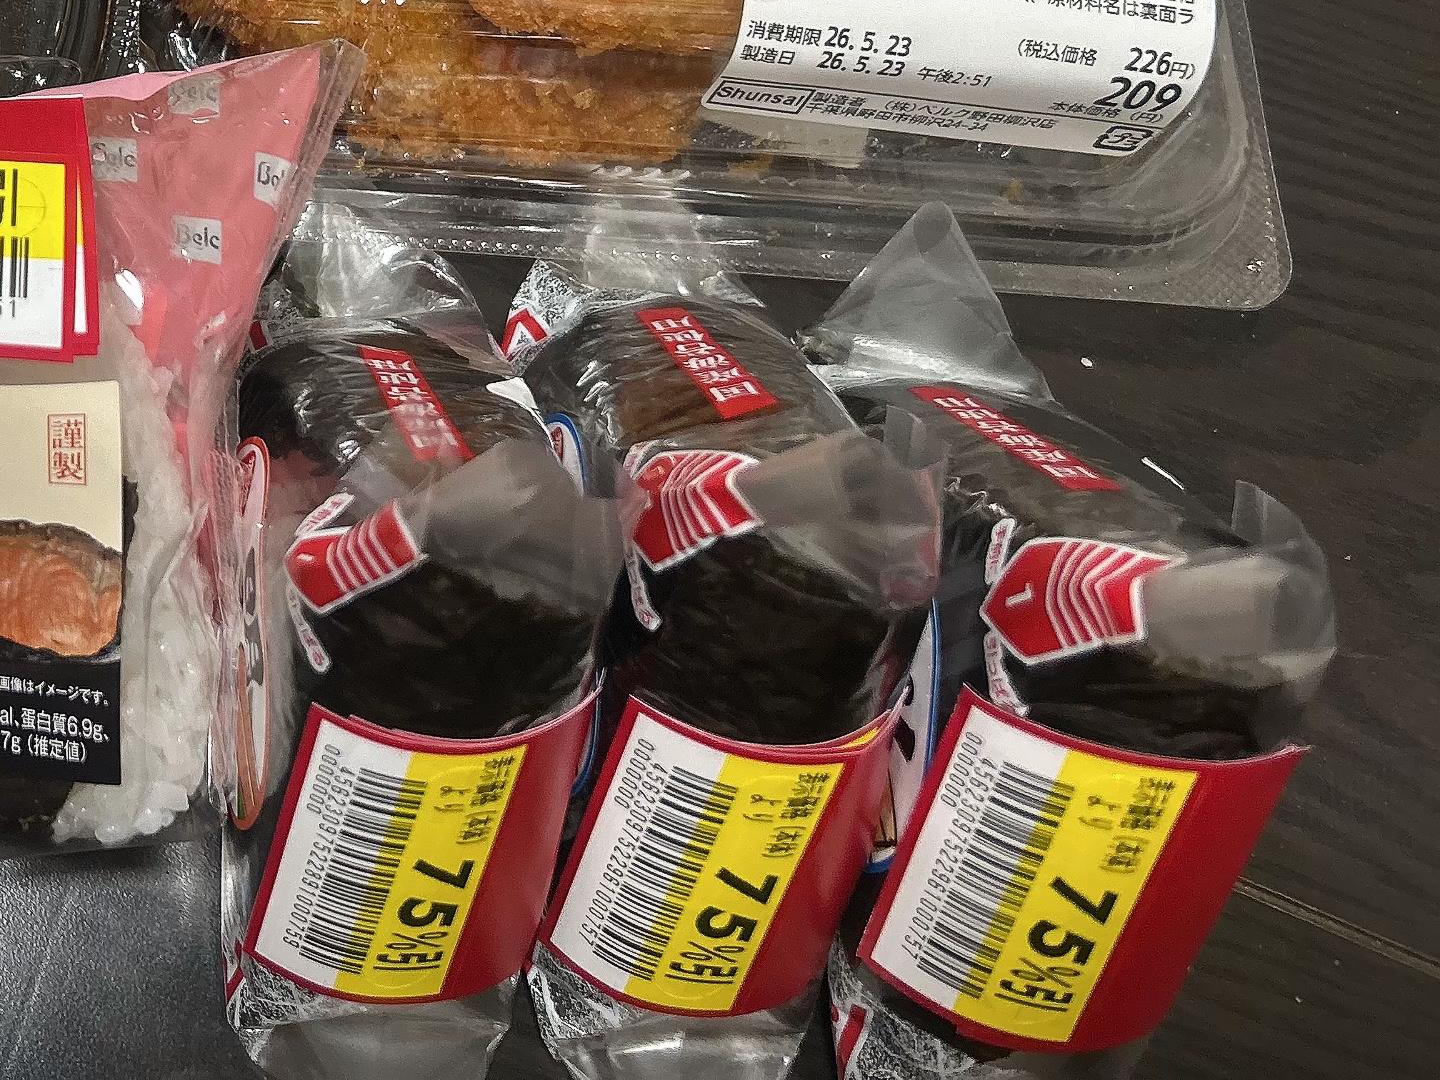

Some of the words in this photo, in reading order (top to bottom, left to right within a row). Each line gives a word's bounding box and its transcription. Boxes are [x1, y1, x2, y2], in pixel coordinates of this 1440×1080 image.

[740, 43, 797, 66] 製造日
[746, 19, 823, 47] 消費期限
[1016, 38, 1098, 68] (税込価格
[811, 91, 867, 108] 製造者
[1092, 75, 1183, 114] 209
[176, 223, 220, 249] Belc
[51, 419, 85, 481] 謹製
[307, 743, 341, 816] 0000000
[433, 785, 474, 814] より
[614, 737, 656, 808] 0000000
[940, 731, 984, 808] 0000000
[742, 793, 783, 823] より
[1077, 794, 1121, 829] より
[282, 765, 357, 950] 45623097522891000759
[578, 761, 667, 947] 45623097522961000757
[900, 757, 998, 960] 45623097522961000757
[372, 858, 476, 972] 75%引
[664, 866, 779, 985] 75%引
[994, 876, 1122, 1014] 75%引
